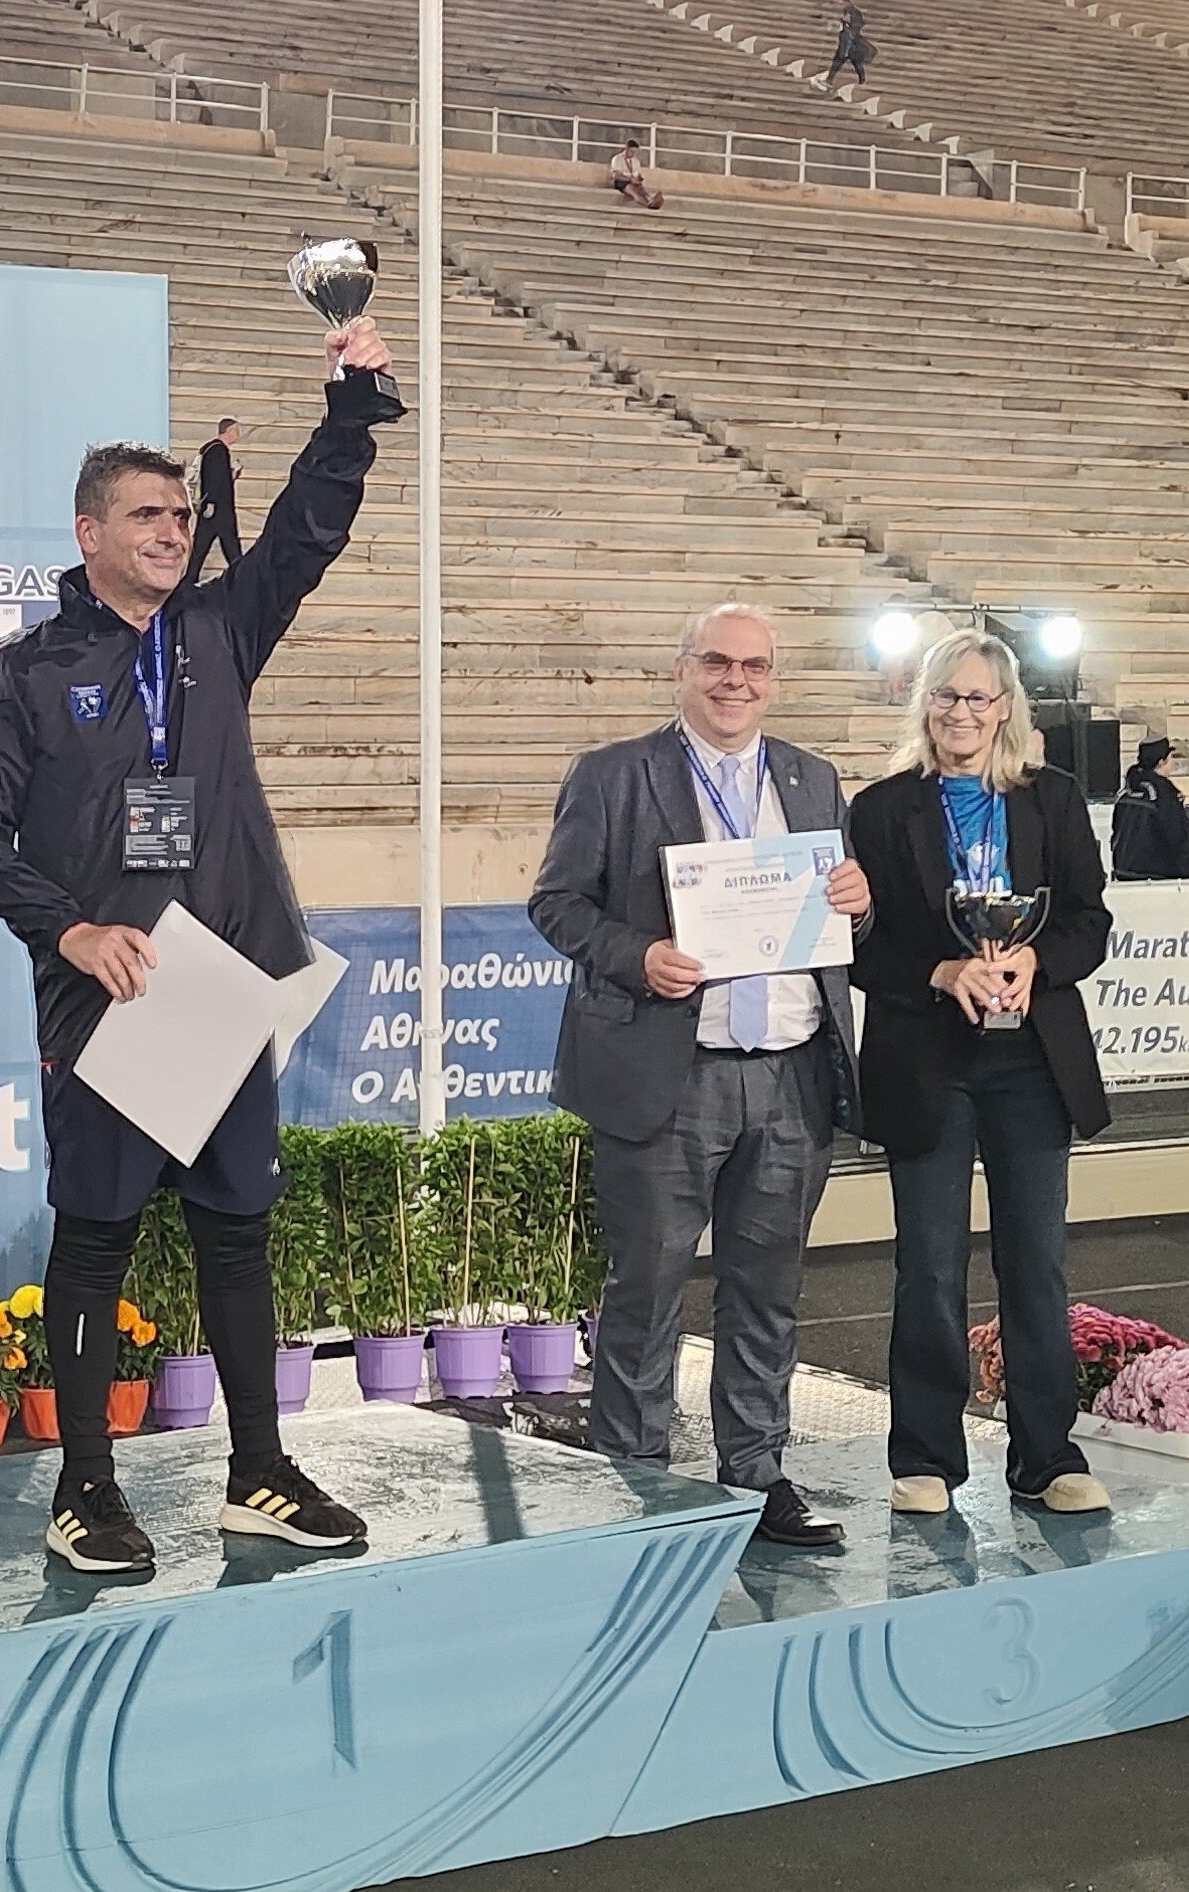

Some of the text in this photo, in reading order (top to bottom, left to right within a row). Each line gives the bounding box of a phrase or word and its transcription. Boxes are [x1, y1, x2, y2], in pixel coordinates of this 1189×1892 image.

[724, 871, 791, 888] ΔΙΠΛΩΜΑ
[1096, 977, 1147, 1007] The
[351, 1071, 385, 1103] Ο
[292, 1609, 358, 1770] 1
